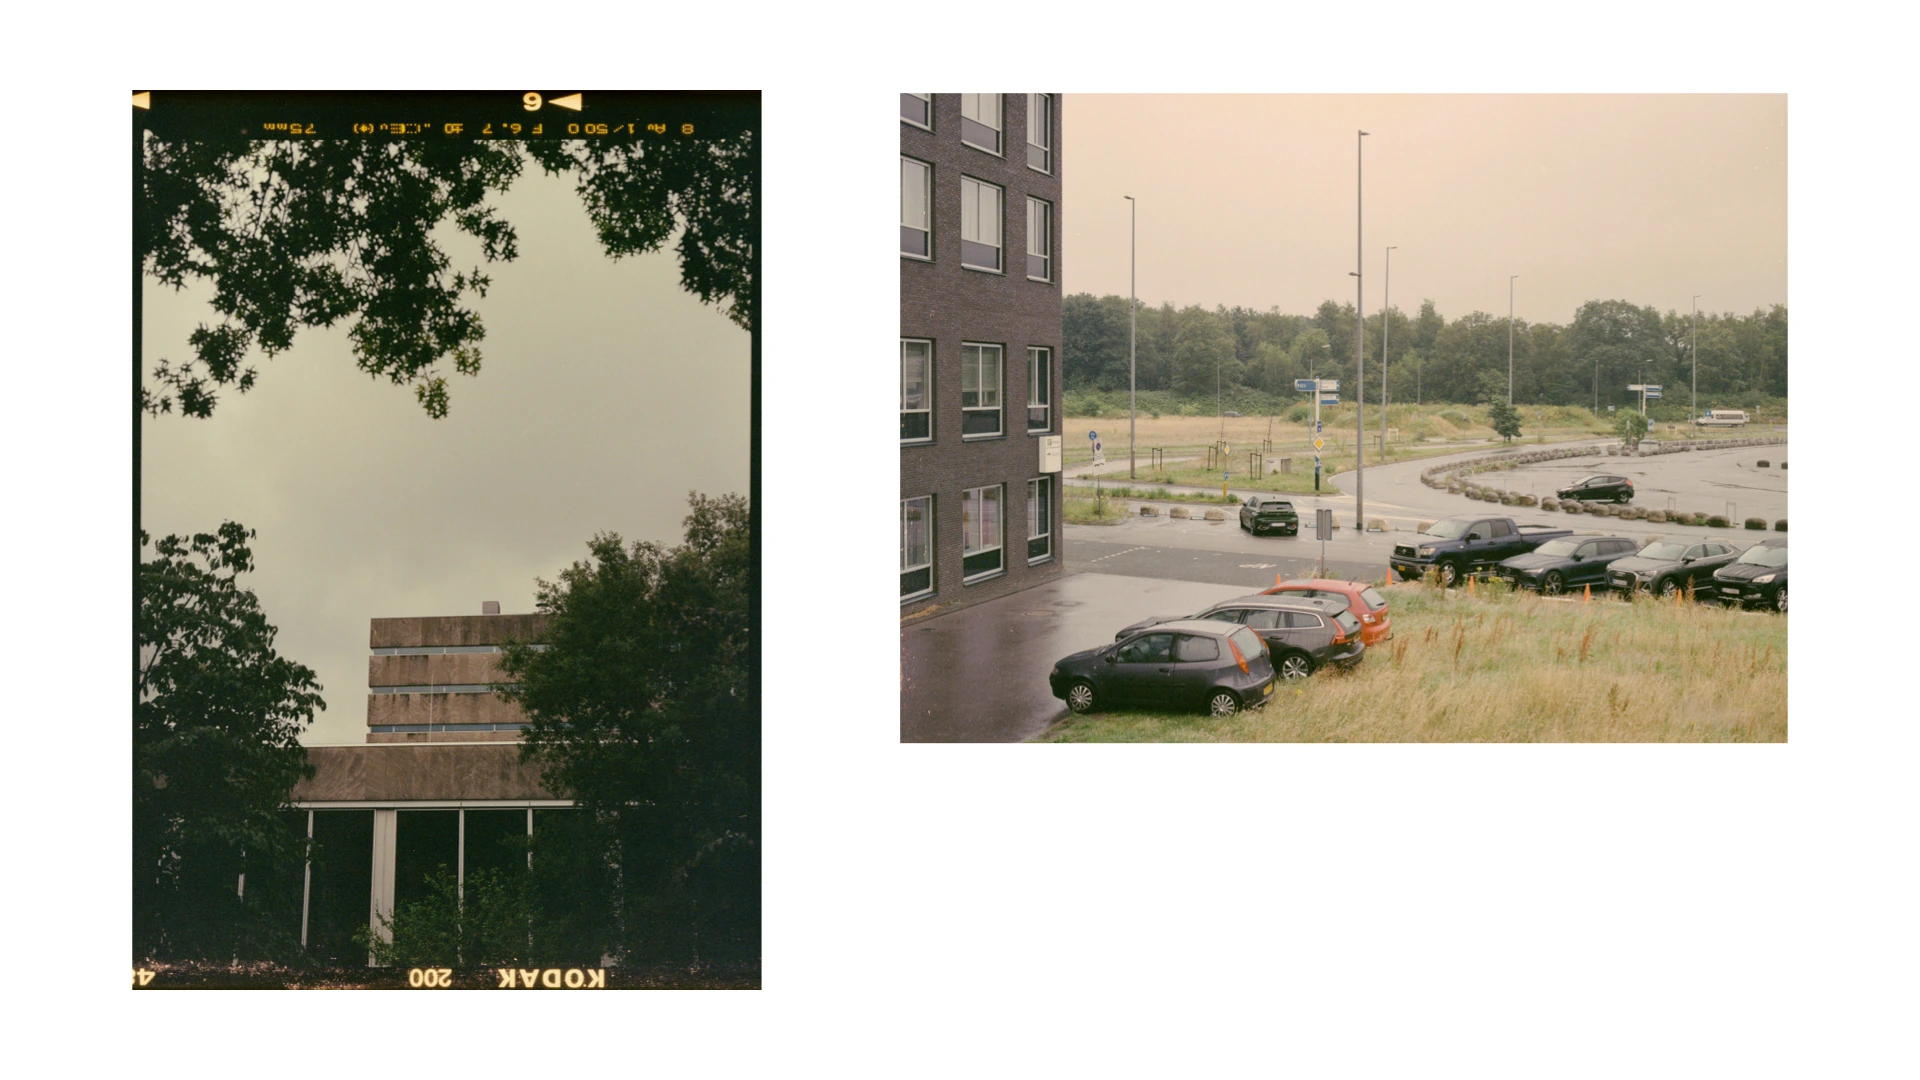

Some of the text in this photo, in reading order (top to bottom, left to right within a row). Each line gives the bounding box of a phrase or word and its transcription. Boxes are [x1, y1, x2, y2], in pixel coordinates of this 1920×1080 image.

[132, 968, 156, 986] 4
[408, 968, 605, 988] KODAK 200
